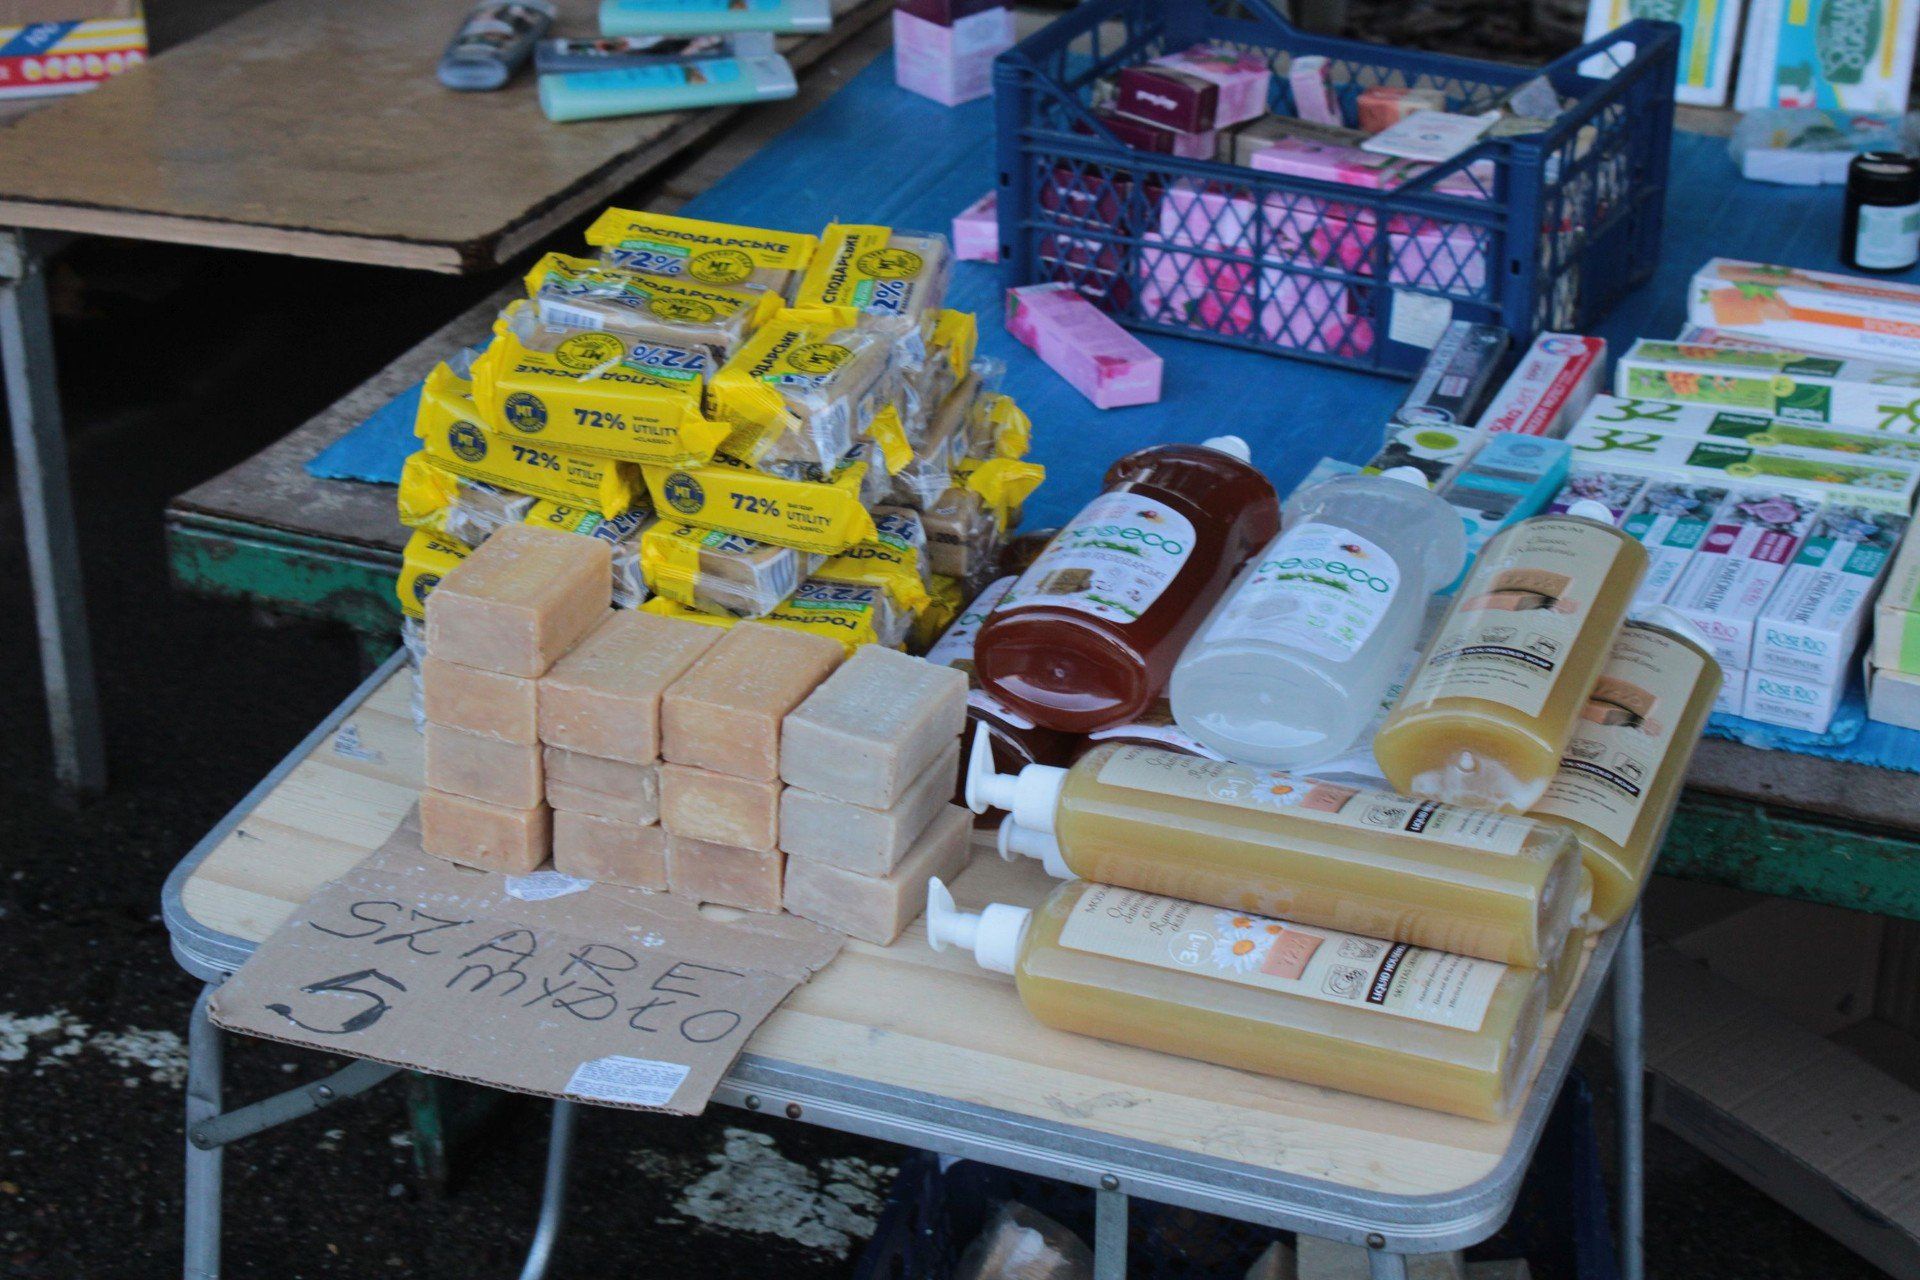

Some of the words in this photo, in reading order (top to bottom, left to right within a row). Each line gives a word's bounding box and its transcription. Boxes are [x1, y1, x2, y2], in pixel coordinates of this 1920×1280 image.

[628, 222, 790, 254] ГОСПОДАРСЬКЕ
[612, 249, 682, 275] 72%
[821, 233, 861, 305] СПОДАРСЬКЕ
[872, 281, 904, 312] 2%
[632, 345, 706, 370] 72%
[748, 330, 799, 379] ОДАРСЬКЕ
[573, 408, 627, 431] 72%
[1595, 399, 1683, 423] 32
[632, 423, 678, 437] UTILITY
[1574, 427, 1664, 453] 32
[512, 445, 561, 471] 72%
[730, 492, 781, 518] 72%
[786, 510, 832, 526] UTILITY
[875, 515, 914, 541] 72
[800, 581, 875, 603] 72%
[1766, 629, 1800, 647] ROSE
[1803, 636, 1828, 652] RIO
[1758, 678, 1791, 696] ROSE
[1795, 686, 1819, 702] RIO
[309, 900, 746, 999] SZARE
[1372, 971, 1391, 1002] LIQUID
[265, 968, 407, 1034] 5
